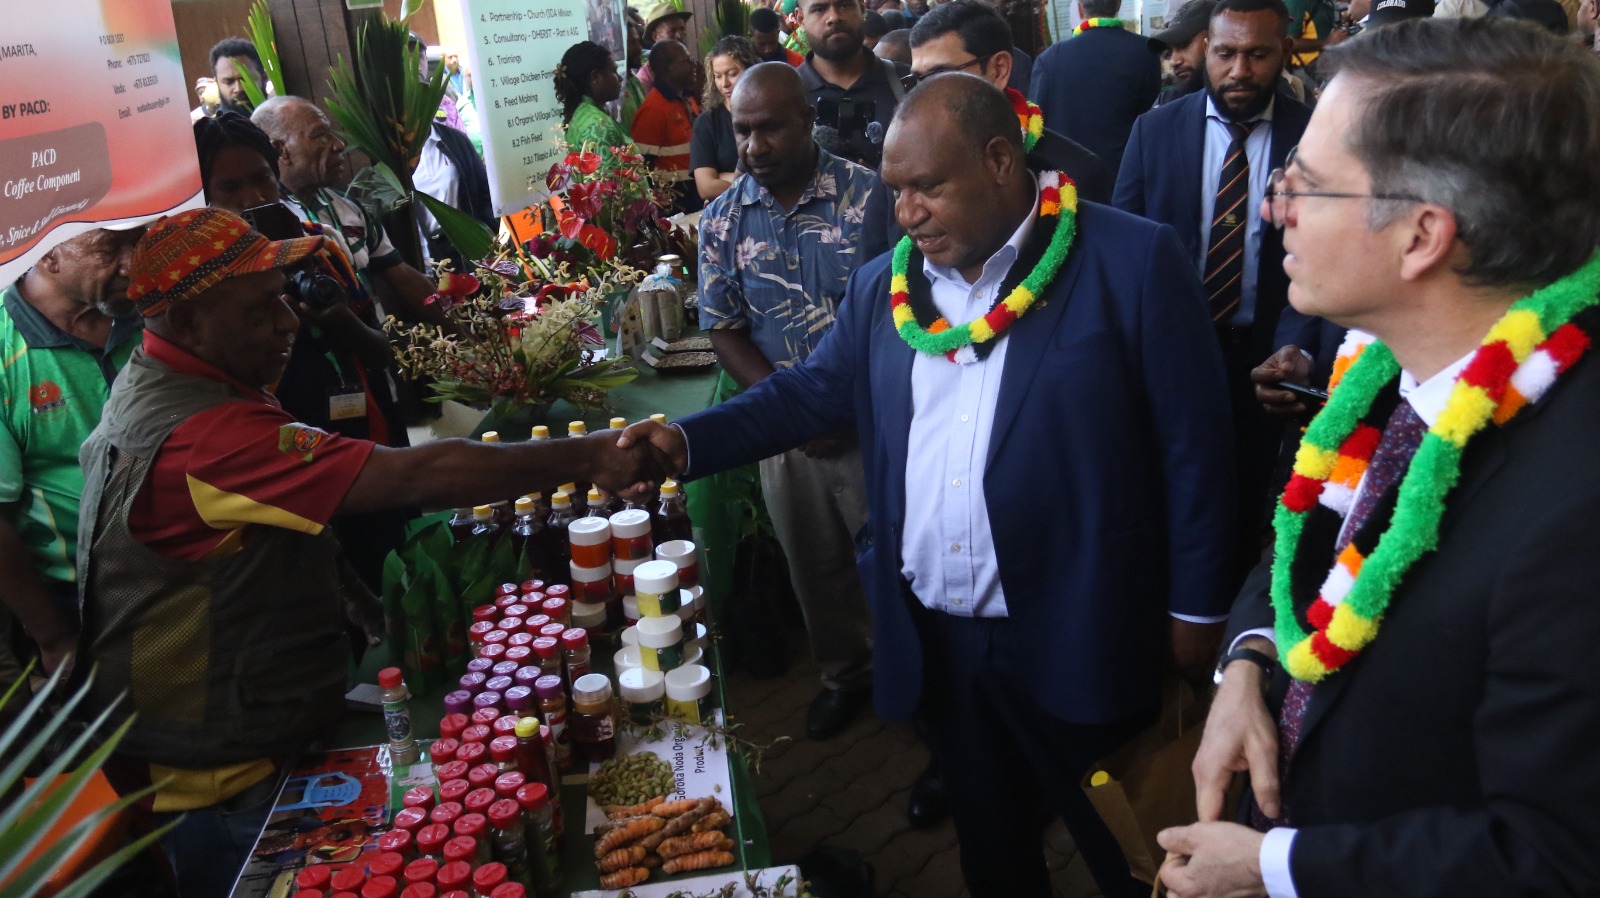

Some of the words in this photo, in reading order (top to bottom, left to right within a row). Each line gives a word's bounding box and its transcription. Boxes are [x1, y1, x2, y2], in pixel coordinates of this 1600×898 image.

[480, 14, 487, 23] 4.
[489, 11, 523, 25] Partnership
[527, 9, 546, 21] Church
[557, 8, 573, 19] Mission
[484, 35, 491, 46] 5.
[494, 31, 528, 46] Consultancy
[1, 44, 38, 58] MARITA,
[487, 58, 495, 66] 6.
[497, 55, 522, 64] Trainings
[491, 79, 498, 88] 7.
[500, 75, 520, 86] Village
[520, 72, 541, 83] Chicken
[2, 104, 17, 119] BY
[20, 100, 51, 117] PACD:
[494, 99, 502, 109] 8.
[503, 96, 518, 107] Feed
[518, 93, 538, 104] Making
[515, 114, 535, 126] Organic
[535, 110, 551, 121] Village
[520, 134, 531, 145] Fish
[531, 131, 543, 143] Feed
[31, 148, 57, 168] PACD
[534, 151, 548, 162] Tilapia
[5, 176, 36, 200] Coffee
[37, 169, 81, 192] Component
[7, 225, 31, 246] Spice
[672, 724, 685, 751] Orgai
[673, 752, 684, 772] Noda
[694, 744, 705, 773] Produt
[675, 772, 686, 800] Goroka
